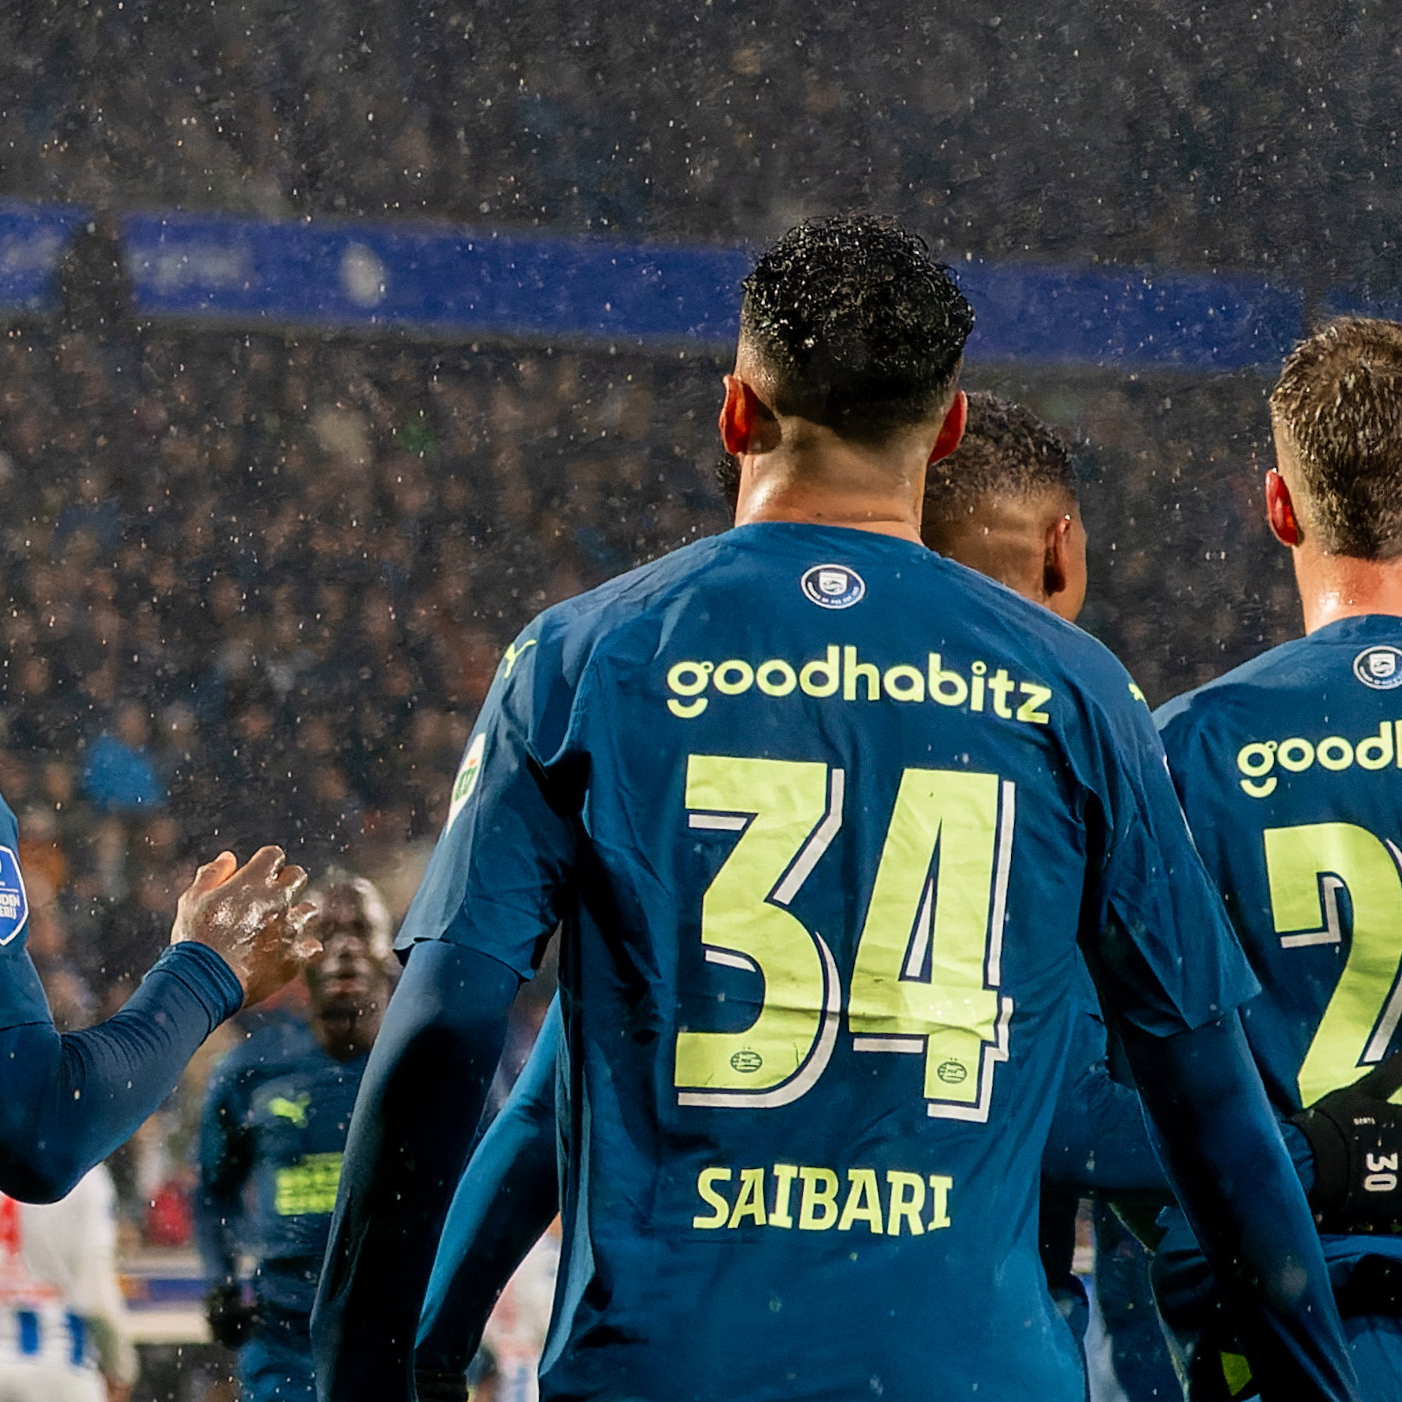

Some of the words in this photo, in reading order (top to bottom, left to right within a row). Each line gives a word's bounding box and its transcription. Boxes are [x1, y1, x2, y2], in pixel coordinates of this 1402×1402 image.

[666, 645, 1051, 725] goodhabitz
[1237, 720, 1402, 798] good
[674, 754, 1015, 1123] 34
[692, 1163, 954, 1236] SAIBARI
